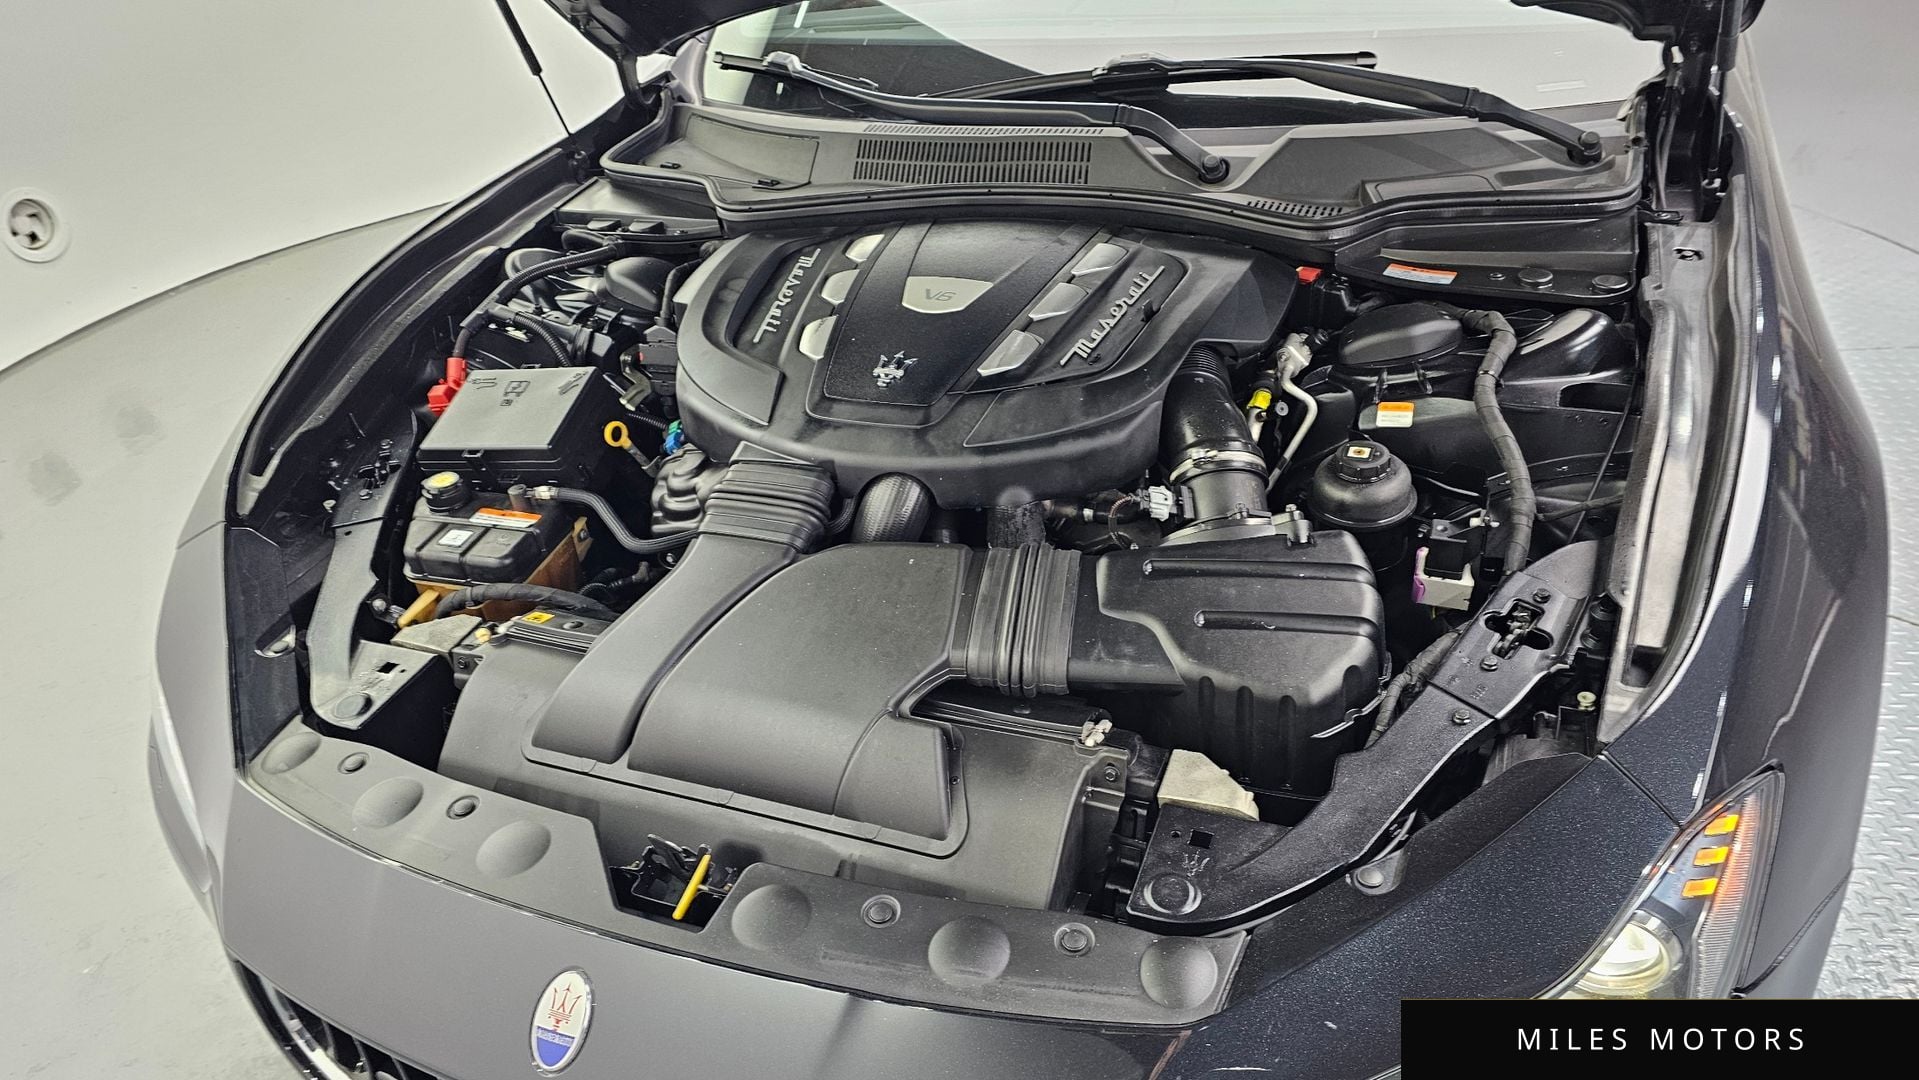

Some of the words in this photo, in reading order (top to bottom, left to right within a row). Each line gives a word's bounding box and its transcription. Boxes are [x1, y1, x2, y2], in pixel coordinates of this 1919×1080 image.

[753, 247, 821, 344] Maserati
[925, 288, 957, 302] V6
[1059, 265, 1165, 366] Maserati
